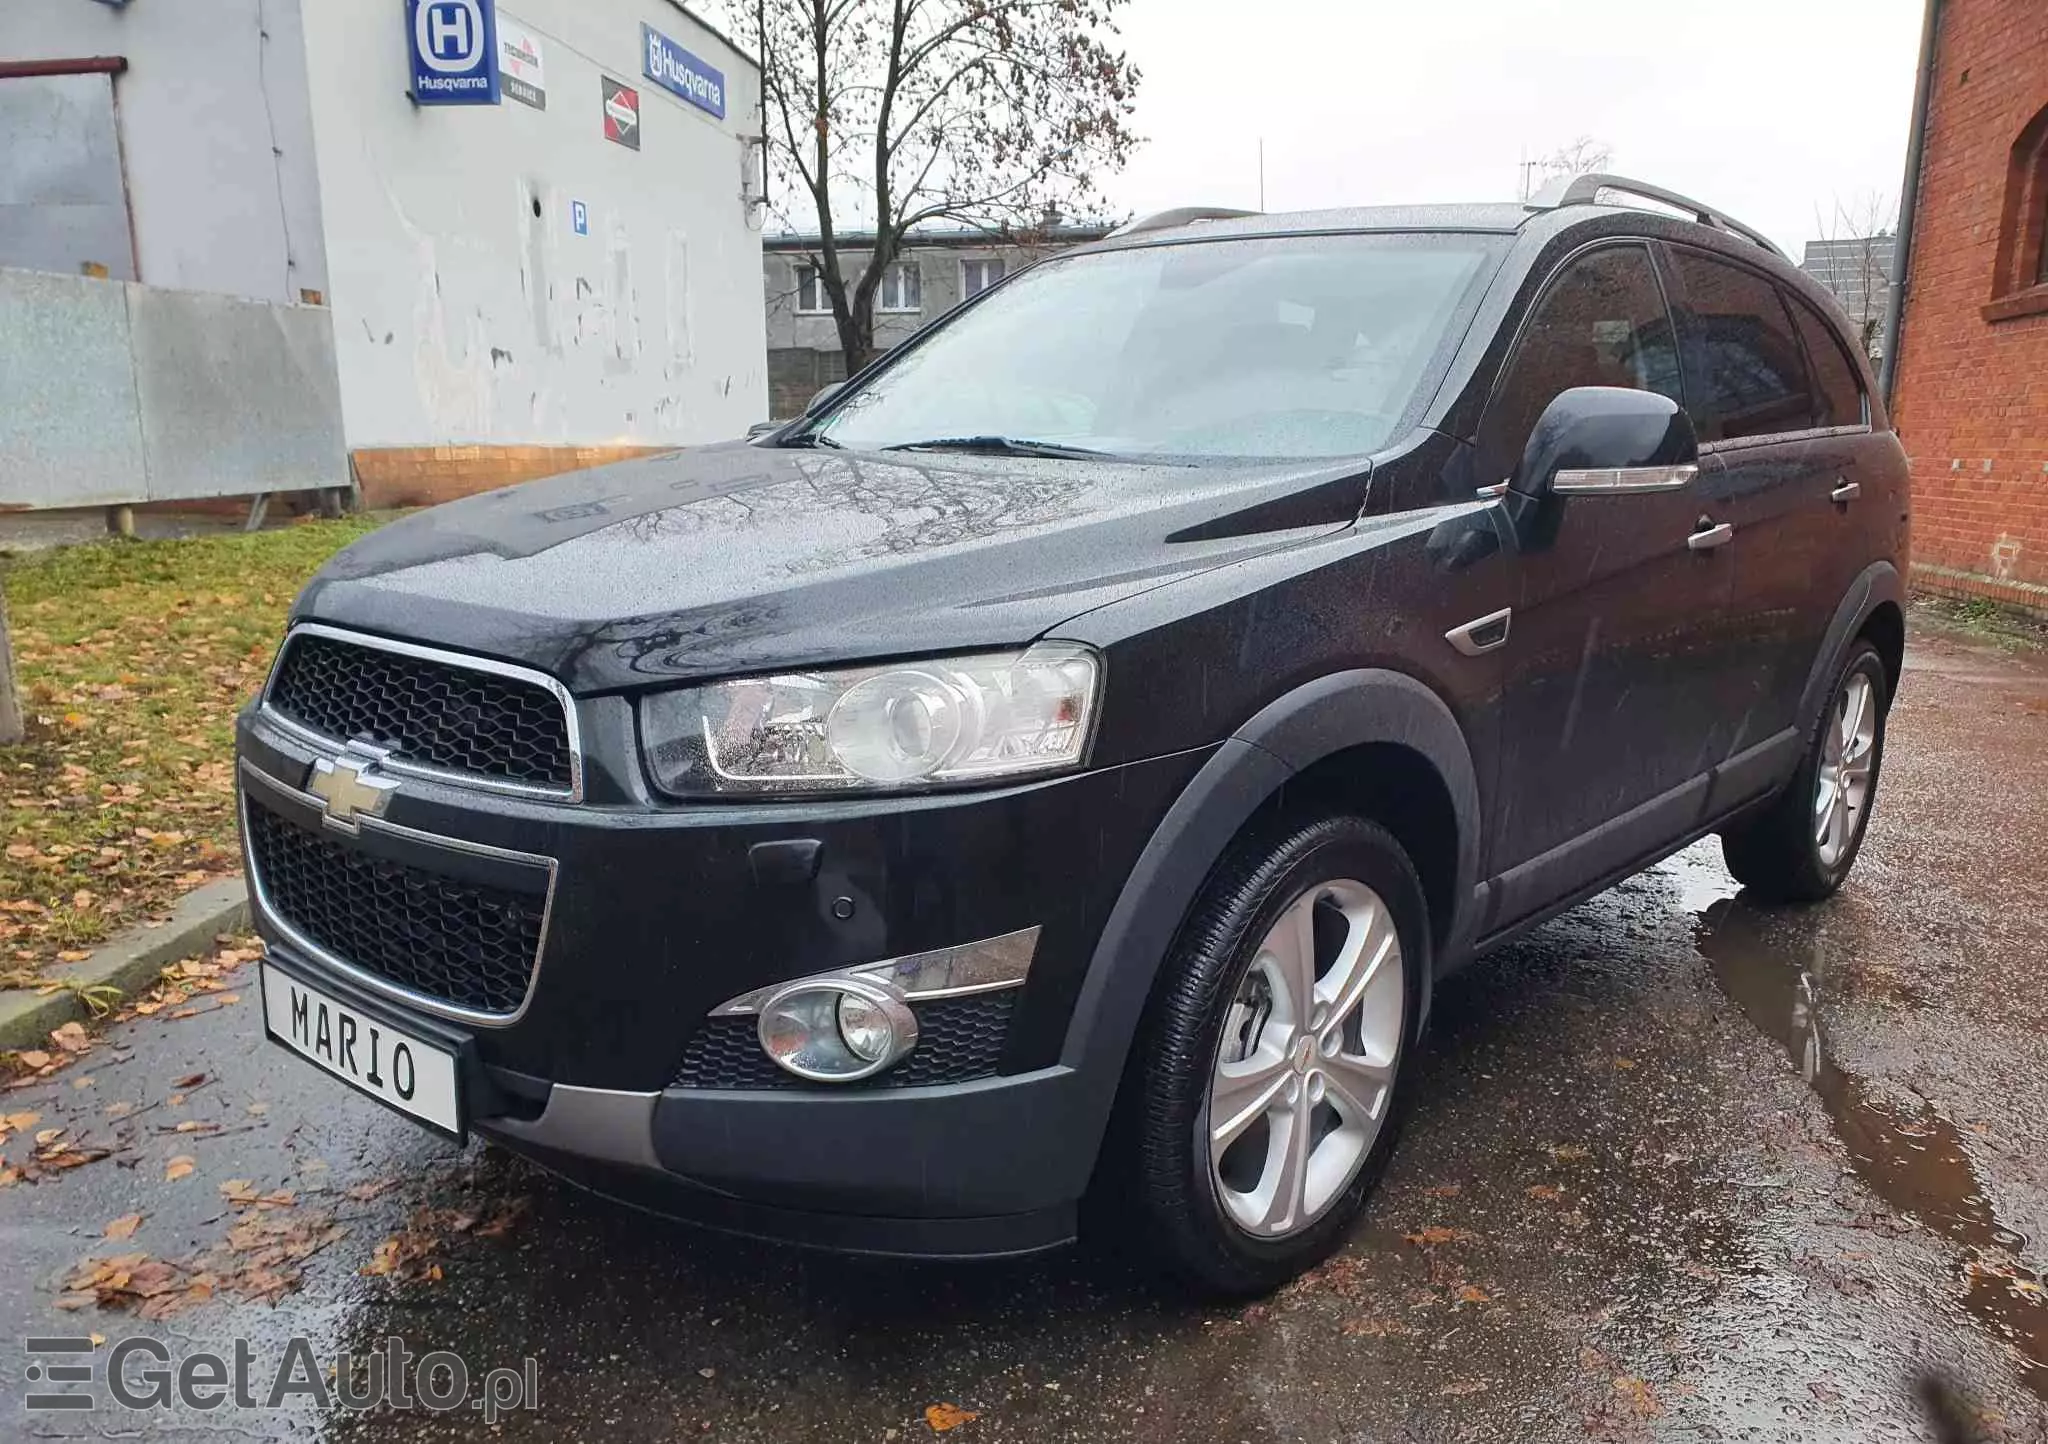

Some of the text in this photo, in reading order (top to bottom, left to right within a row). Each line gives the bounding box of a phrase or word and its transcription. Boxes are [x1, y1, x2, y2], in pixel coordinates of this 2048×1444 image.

[432, 8, 468, 54] H
[418, 75, 488, 92] Husqvarna
[662, 45, 721, 107] Husqvarna
[575, 204, 585, 231] P
[291, 986, 415, 1101] MARIO
